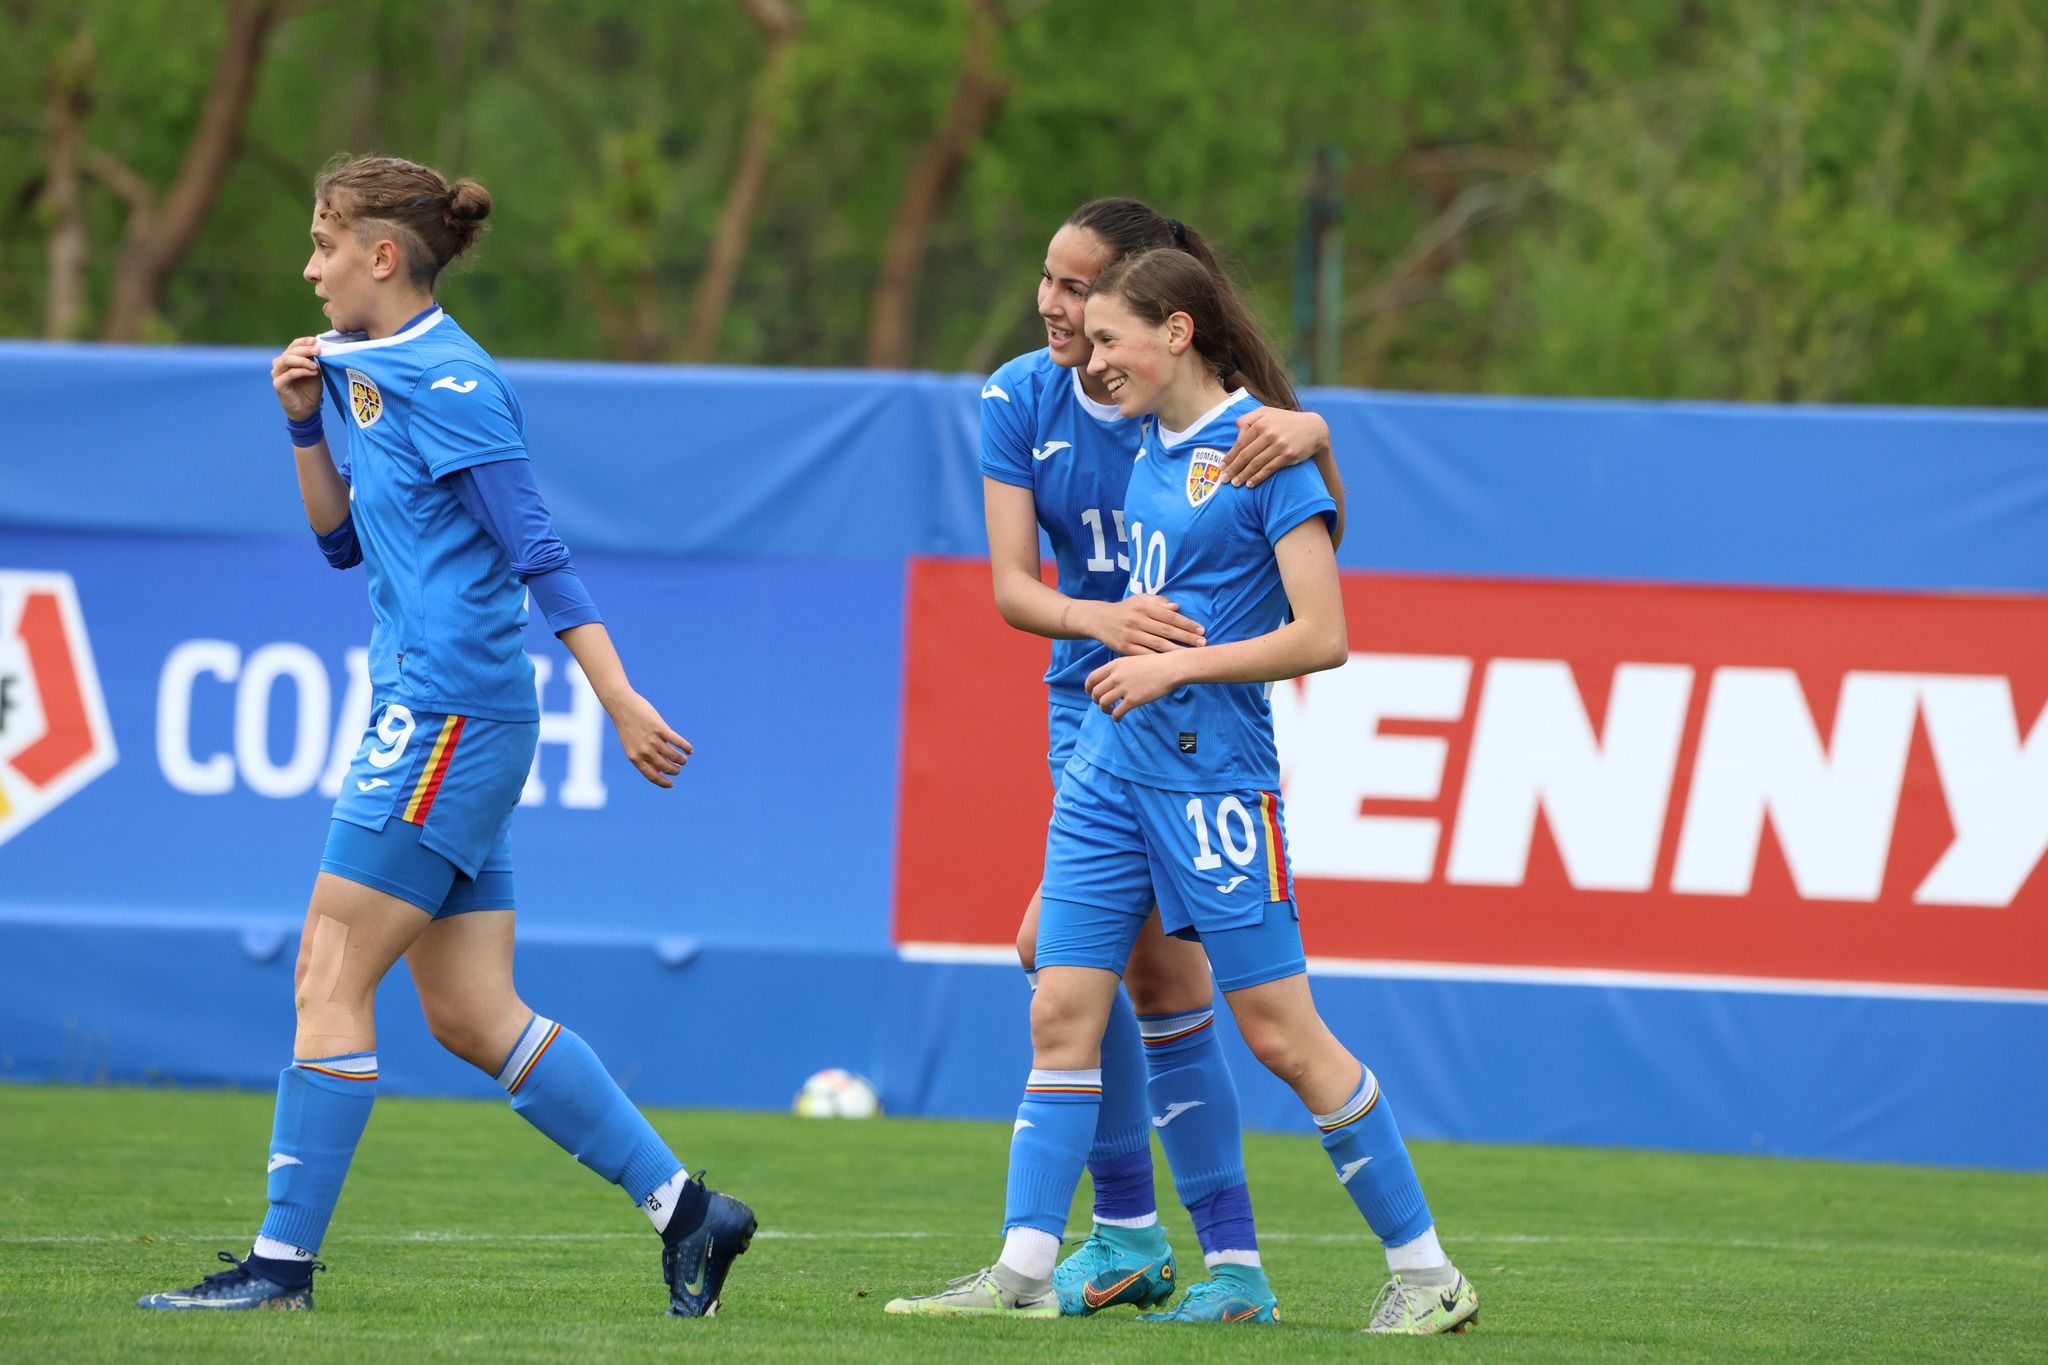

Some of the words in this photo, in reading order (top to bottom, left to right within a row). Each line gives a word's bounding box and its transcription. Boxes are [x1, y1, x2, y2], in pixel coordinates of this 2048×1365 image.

[1195, 451, 1221, 464] ROMÂNI
[1129, 521, 1167, 595] 10
[156, 639, 608, 810] COH
[368, 704, 416, 768] 9
[1273, 651, 2048, 908] ENNY
[1185, 796, 1257, 871] 10
